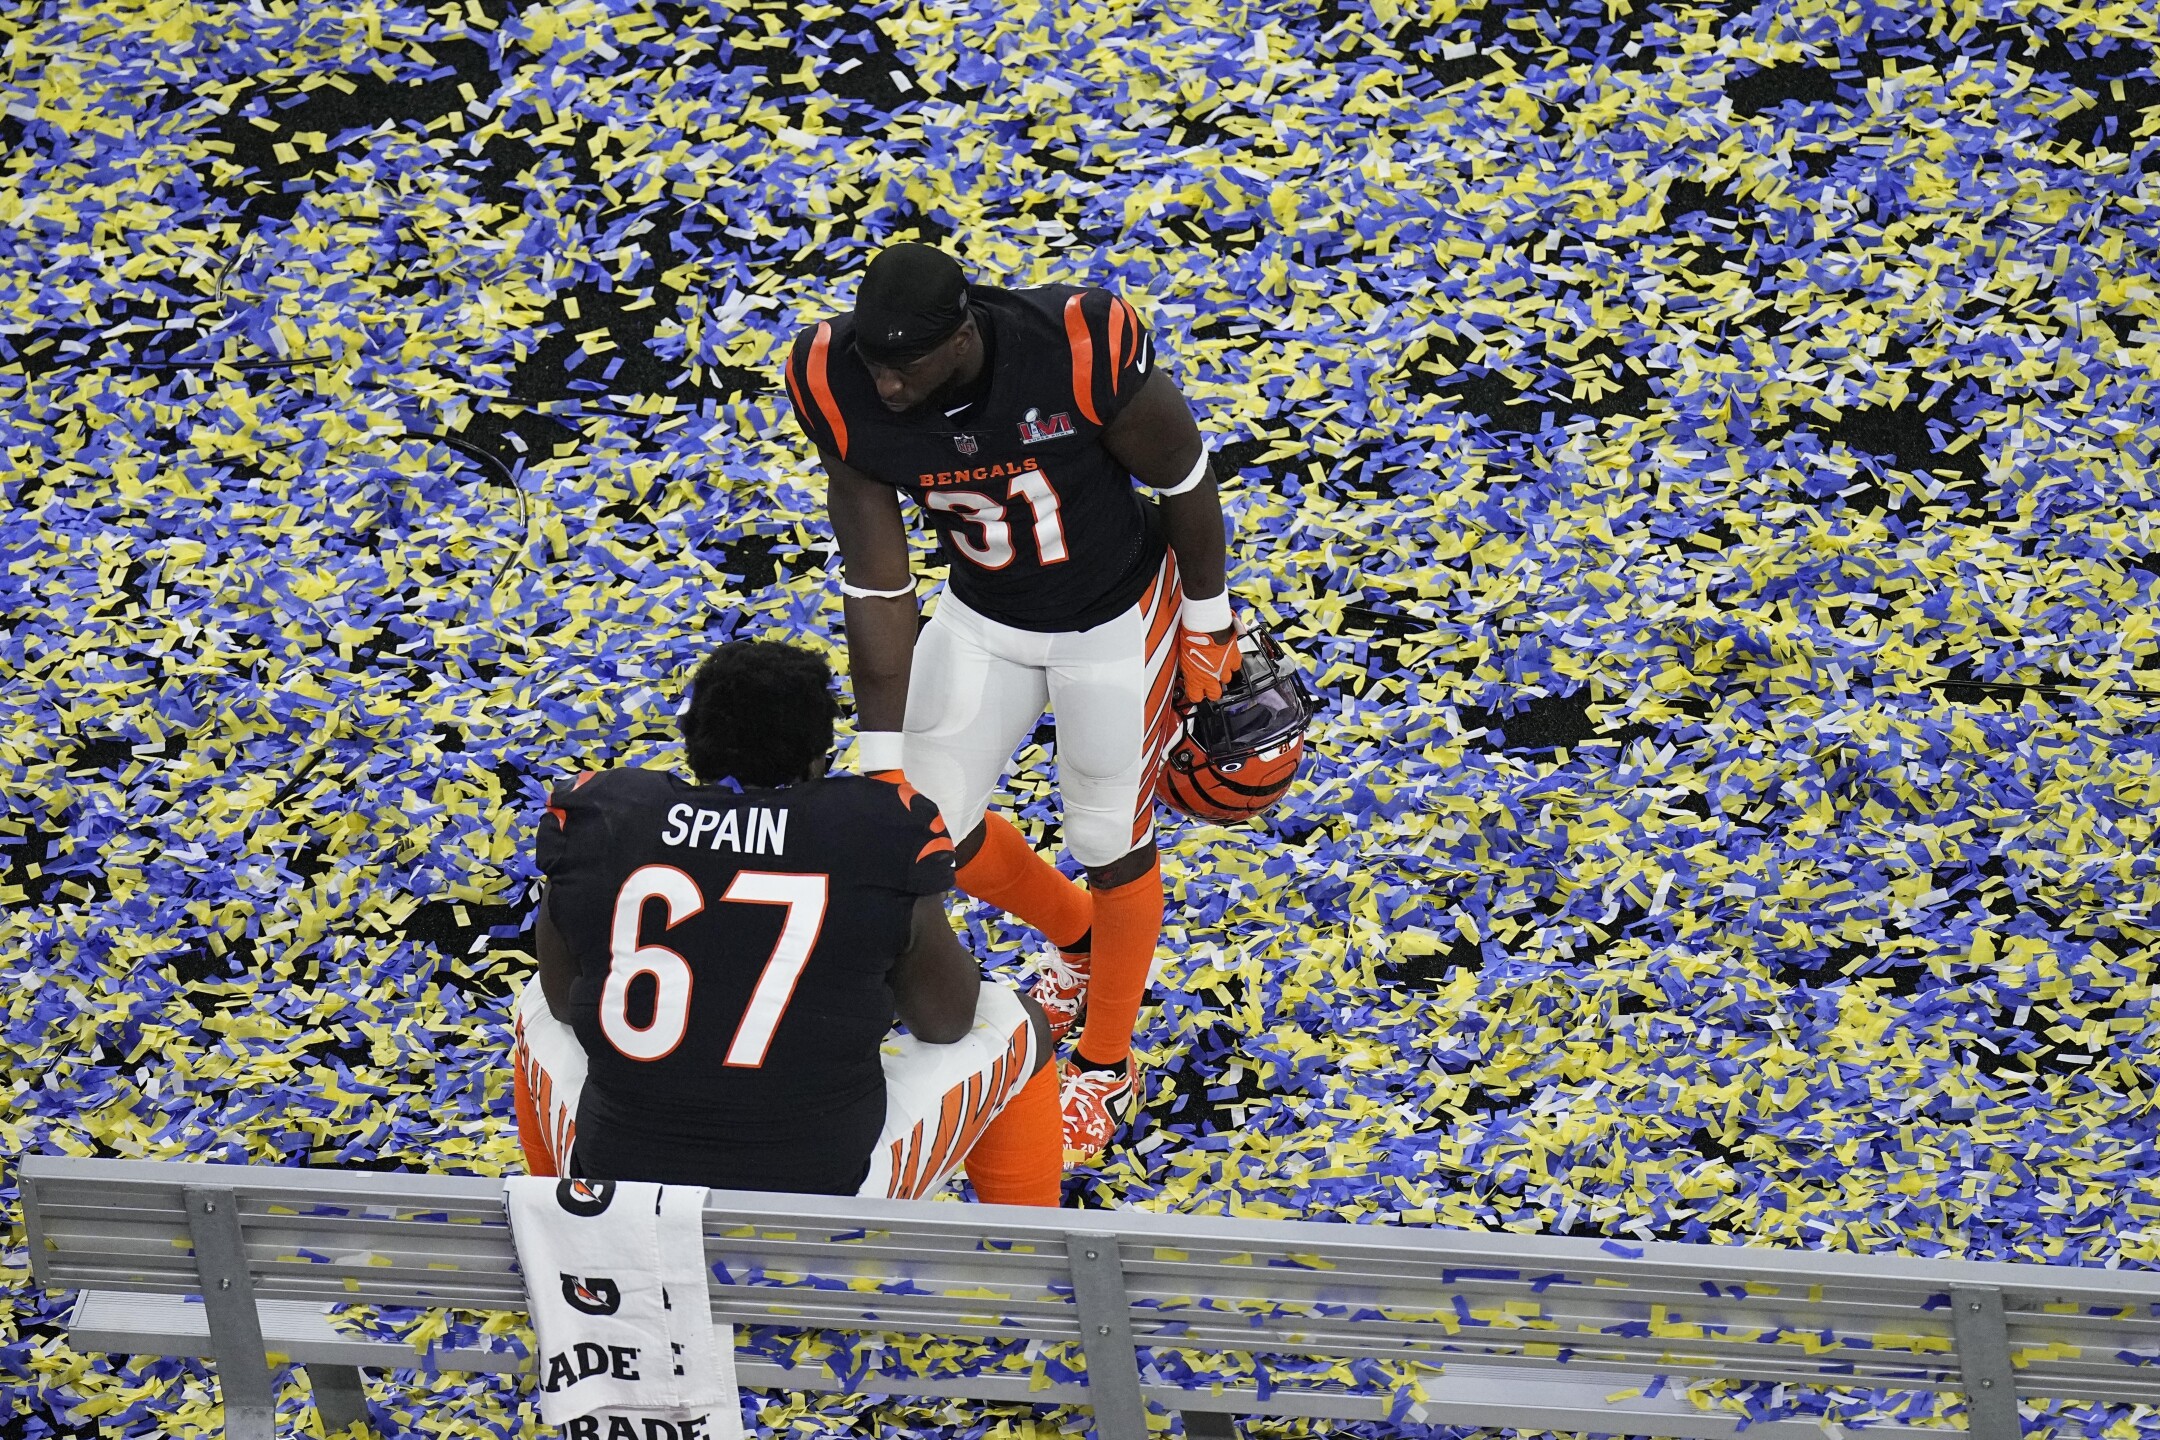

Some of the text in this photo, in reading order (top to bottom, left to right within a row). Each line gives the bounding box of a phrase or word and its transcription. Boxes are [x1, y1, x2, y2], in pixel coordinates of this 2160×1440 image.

[1017, 412, 1072, 441] LVI
[919, 457, 1038, 487] BENGALS
[925, 468, 1070, 571] 31
[661, 803, 789, 856] SPAIN
[600, 864, 829, 1069] 67
[538, 1342, 641, 1393] ADE
[562, 1414, 710, 1440] RADE
